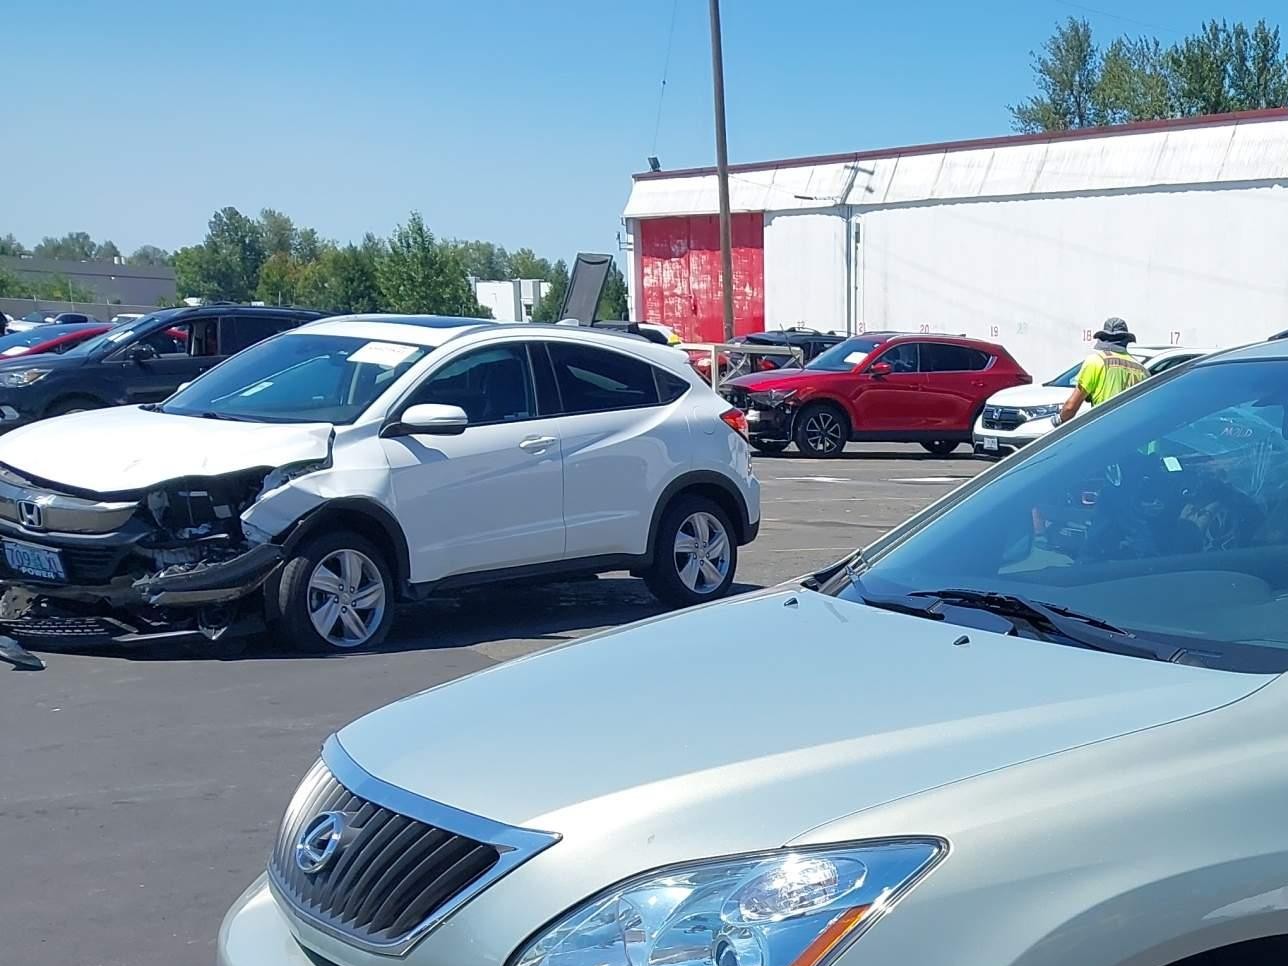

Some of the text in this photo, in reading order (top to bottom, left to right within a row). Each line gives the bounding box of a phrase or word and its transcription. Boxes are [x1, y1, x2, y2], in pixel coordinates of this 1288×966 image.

[920, 323, 931, 335] 20
[990, 326, 999, 337] 19
[1083, 329, 1092, 342] 18
[1170, 331, 1181, 345] 17
